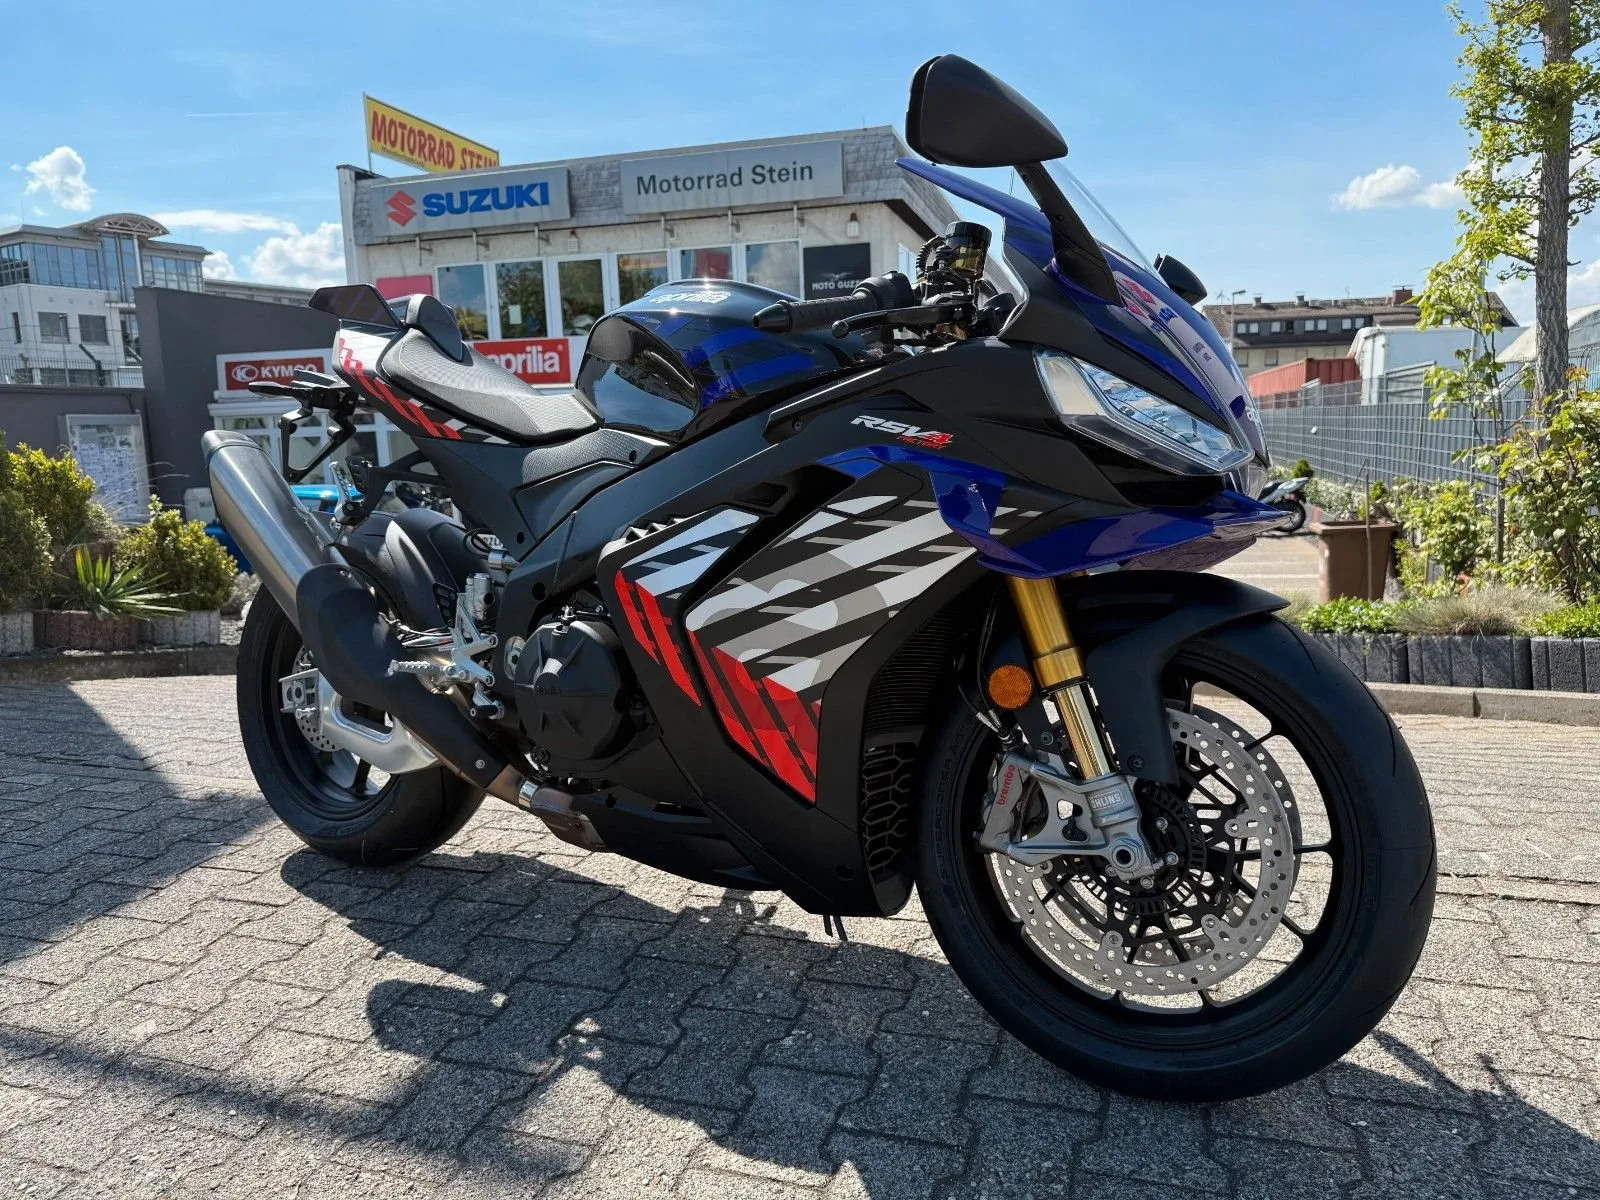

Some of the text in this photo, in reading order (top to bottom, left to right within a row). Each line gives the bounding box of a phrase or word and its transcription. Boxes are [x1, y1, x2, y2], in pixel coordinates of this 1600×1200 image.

[371, 111, 455, 169] MOTORRAD
[637, 161, 813, 195] Motorrad Stein
[422, 182, 549, 217] SUZUKI
[812, 282, 835, 291] MOTO
[996, 764, 1016, 806] brembo
